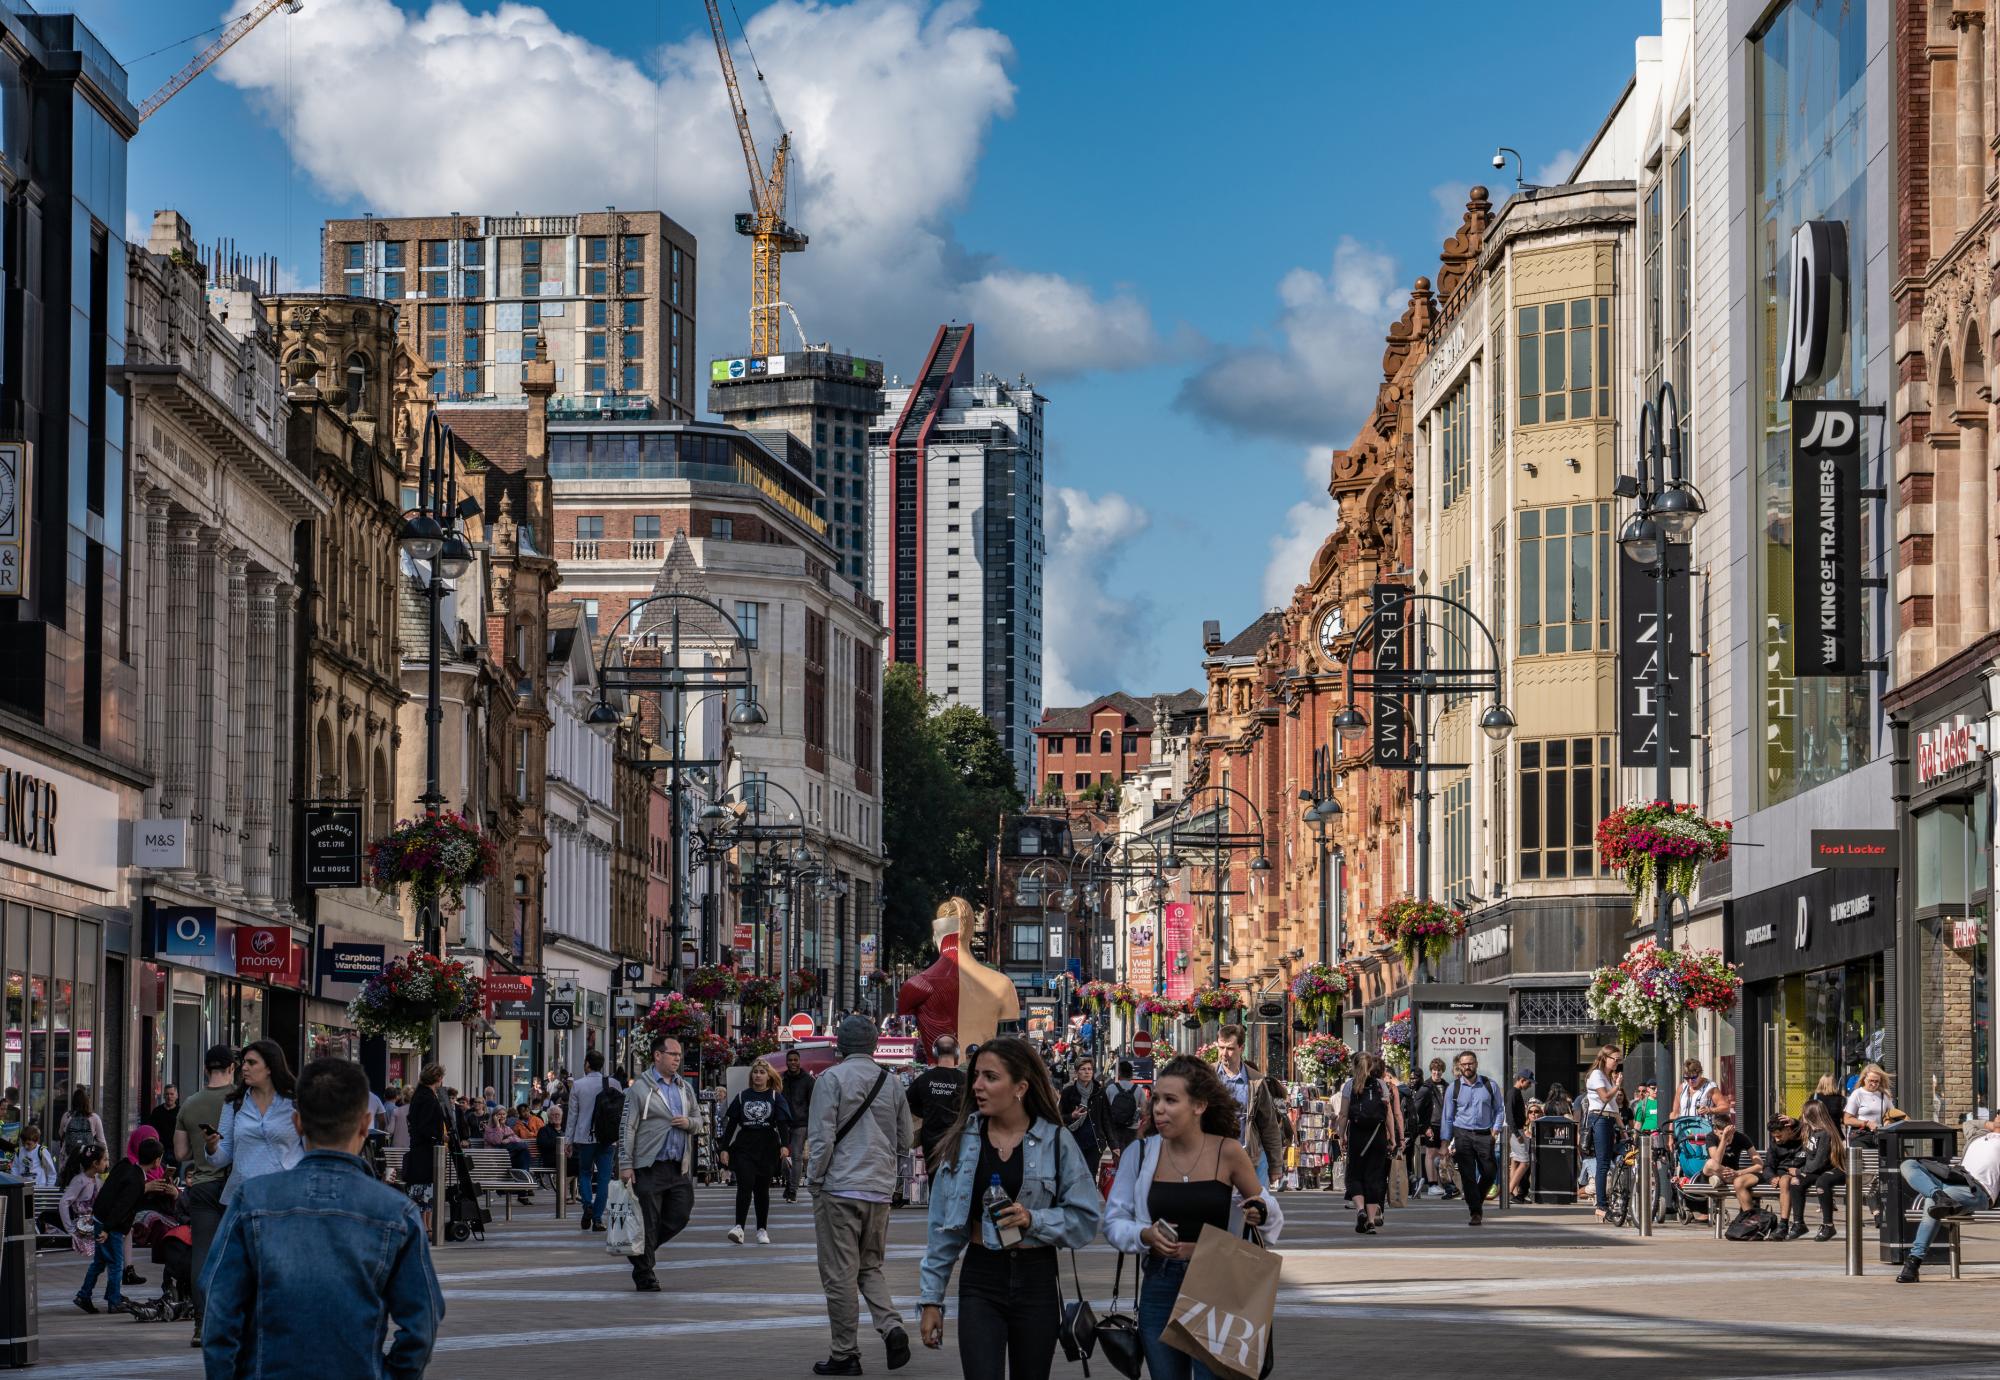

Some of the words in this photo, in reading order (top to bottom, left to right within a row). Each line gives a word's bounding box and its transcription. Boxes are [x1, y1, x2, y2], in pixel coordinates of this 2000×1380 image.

[1800, 411, 1855, 448] JD
[1820, 458, 1836, 556] TRAINERS
[1820, 560, 1836, 580] OF
[1820, 582, 1836, 630] KING
[1632, 613, 1680, 753] ZARA
[310, 824, 353, 837] WHITELOCKS
[145, 834, 175, 847] M&S
[1795, 896, 1808, 950] JD
[241, 956, 285, 969] money
[339, 953, 382, 963] Carphone
[1132, 960, 1152, 968] Well
[335, 962, 382, 971] Warehouse
[1132, 967, 1152, 975] done
[1442, 1027, 1481, 1035] YOUTH
[1431, 1037, 1456, 1045] CAN
[1460, 1037, 1477, 1045] DO
[1480, 1037, 1491, 1045] IT
[928, 1081, 957, 1089] Personal
[931, 1088, 953, 1096] Trainer
